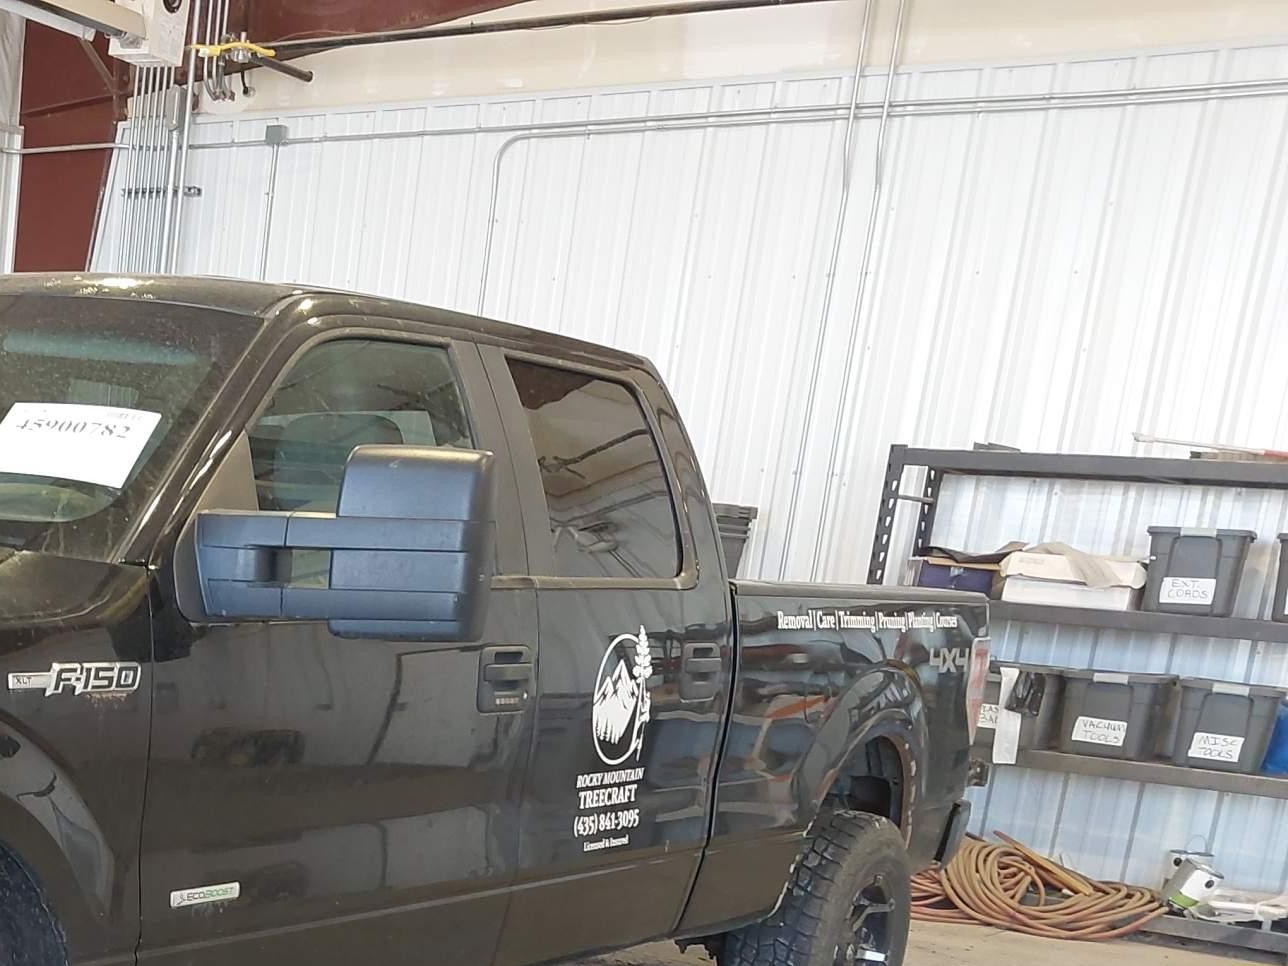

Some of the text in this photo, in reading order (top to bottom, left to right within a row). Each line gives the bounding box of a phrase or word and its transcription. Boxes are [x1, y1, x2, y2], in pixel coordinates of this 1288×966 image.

[15, 417, 132, 439] 45900782
[777, 610, 813, 630] Removal
[817, 611, 836, 630] Care
[839, 611, 876, 633] Trimming
[879, 612, 906, 633] Pruning
[15, 676, 32, 685] XLT
[1199, 735, 1242, 747] MISC
[576, 767, 645, 788] ROCKY MOUNTAIN
[578, 784, 638, 809] TREECRAFT
[573, 809, 640, 838] (435) 841-3095
